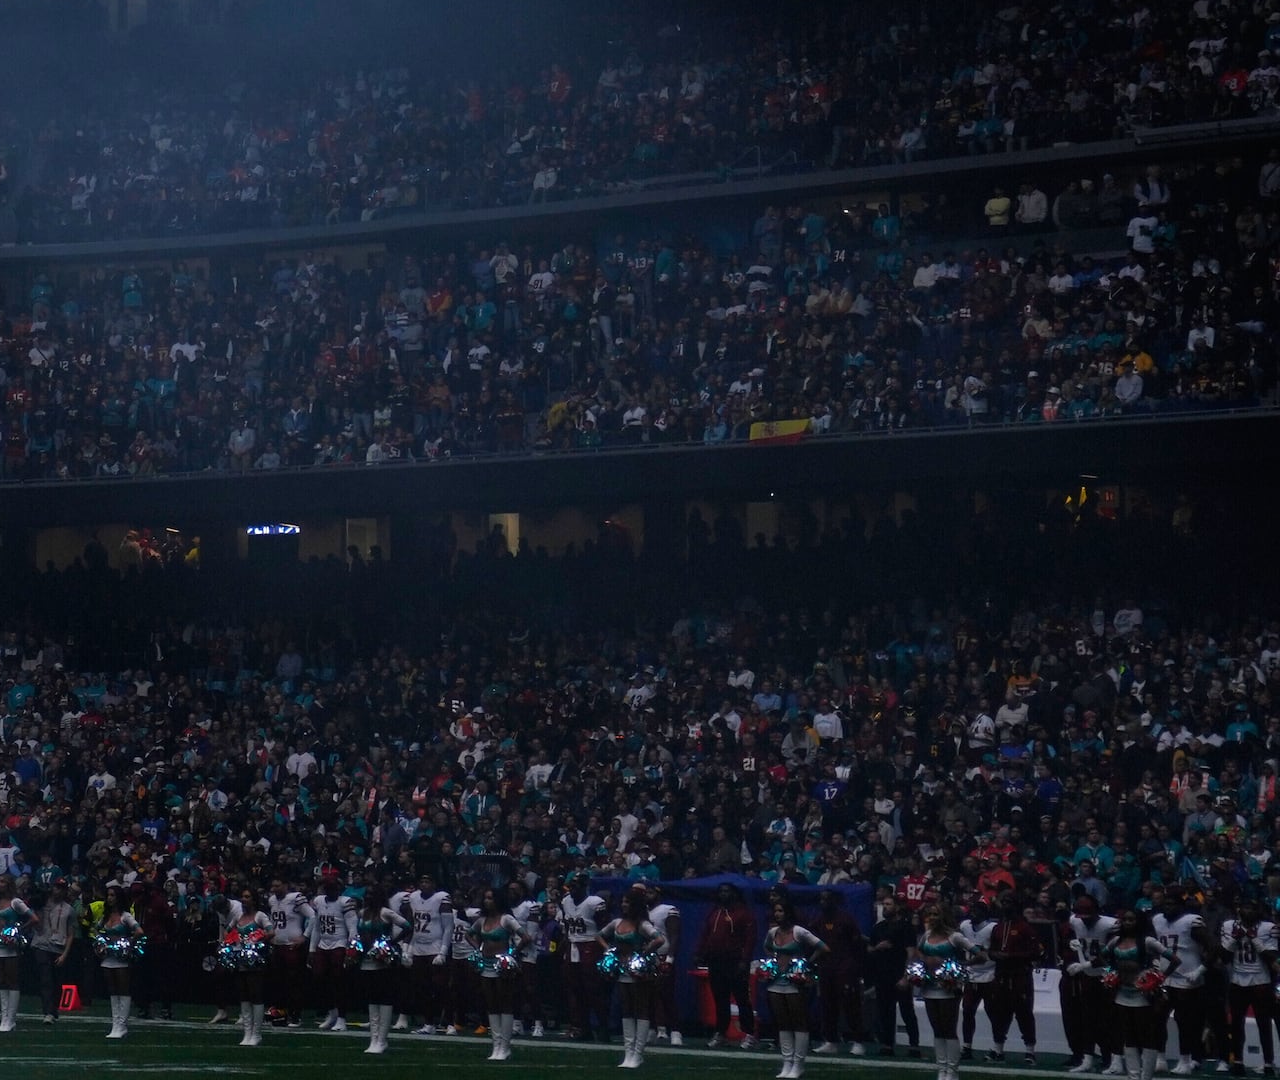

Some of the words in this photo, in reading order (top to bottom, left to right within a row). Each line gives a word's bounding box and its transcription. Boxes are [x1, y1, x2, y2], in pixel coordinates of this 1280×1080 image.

[833, 250, 846, 263] 34
[743, 758, 756, 771] 21
[824, 788, 838, 800] 17
[4, 854, 10, 868] 1
[41, 872, 53, 884] 17
[907, 884, 925, 900] 87
[415, 913, 431, 933] 52
